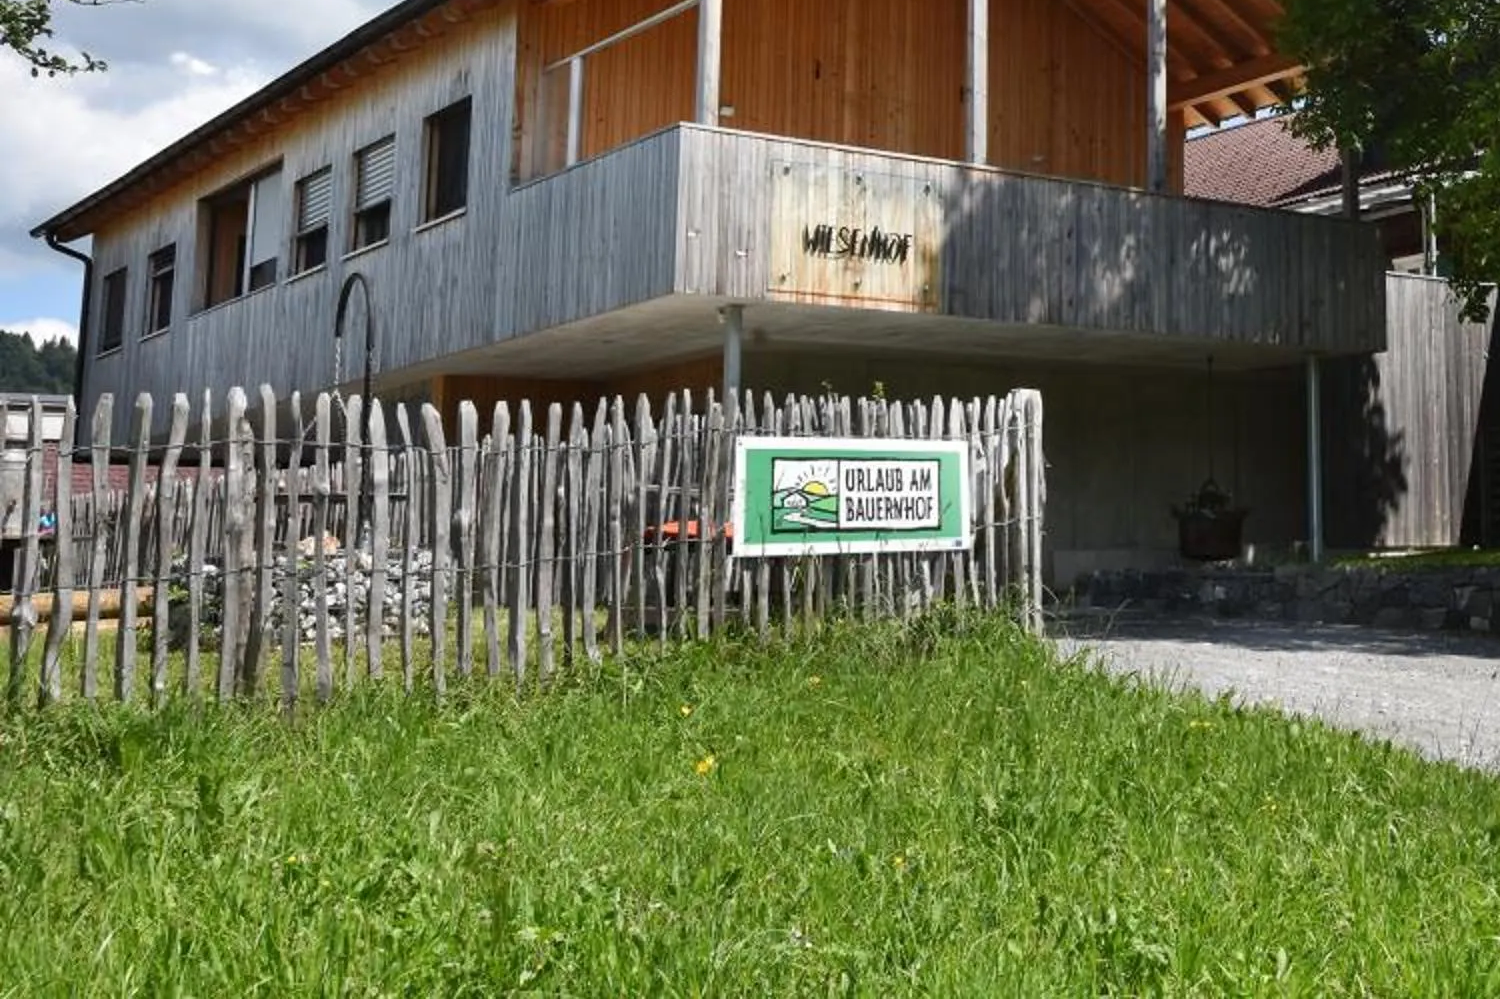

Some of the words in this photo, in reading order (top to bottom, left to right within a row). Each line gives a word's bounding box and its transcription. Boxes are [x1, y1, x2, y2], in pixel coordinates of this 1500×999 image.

[845, 468, 903, 492] URLAUB
[909, 468, 932, 492] AM
[845, 496, 933, 521] BAUERNHOF
